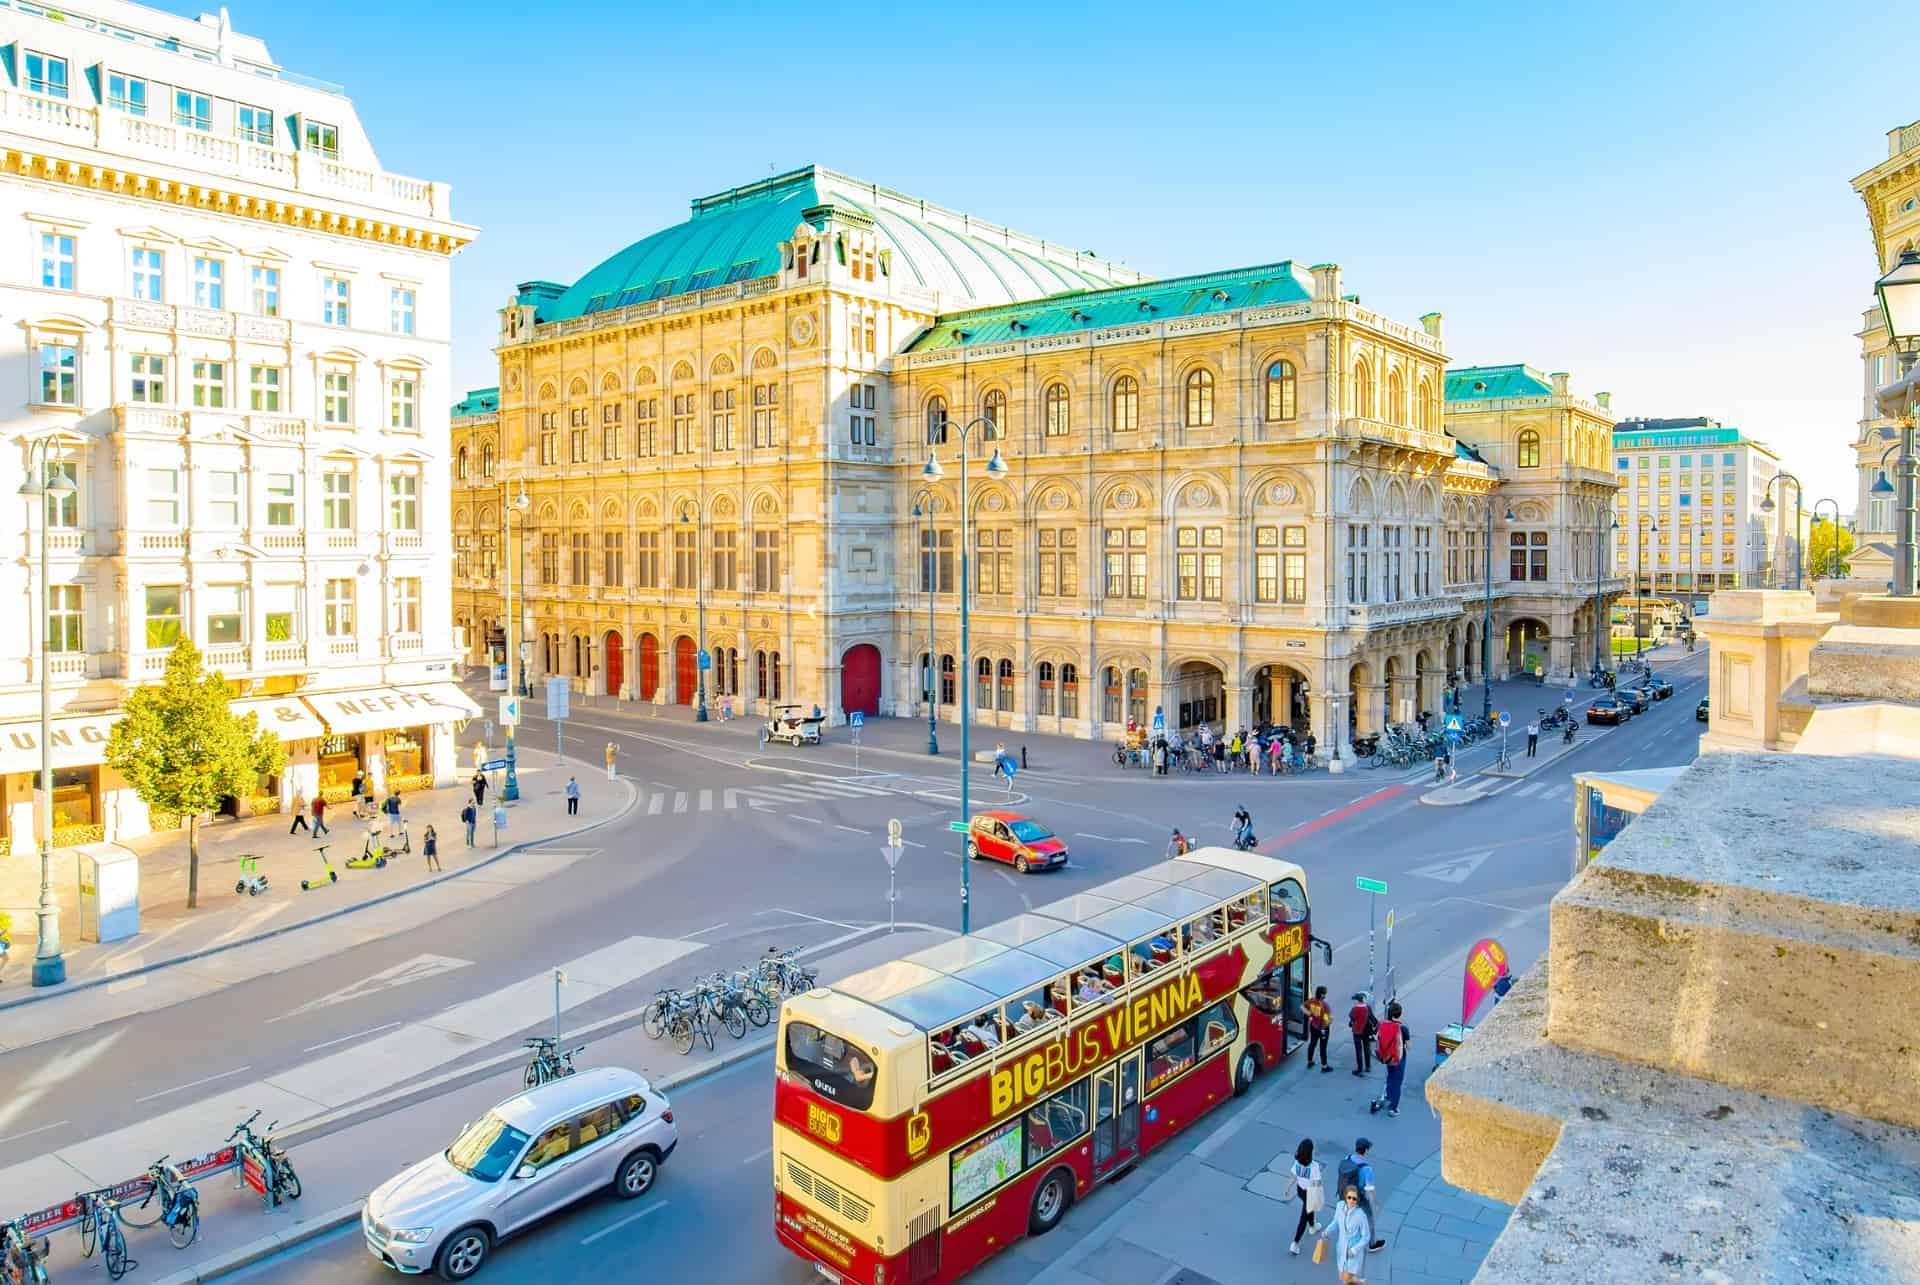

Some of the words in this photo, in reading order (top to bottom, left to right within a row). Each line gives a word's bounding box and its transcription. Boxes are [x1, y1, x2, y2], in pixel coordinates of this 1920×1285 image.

[0, 725, 108, 750] UNG
[274, 705, 305, 722] &
[335, 692, 437, 716] NEFFE
[1276, 930, 1291, 951] BIG
[1106, 972, 1203, 1050] VIENNA
[809, 1103, 826, 1124] BIG
[809, 1117, 826, 1138] BUS
[19, 1207, 61, 1228] URIER
